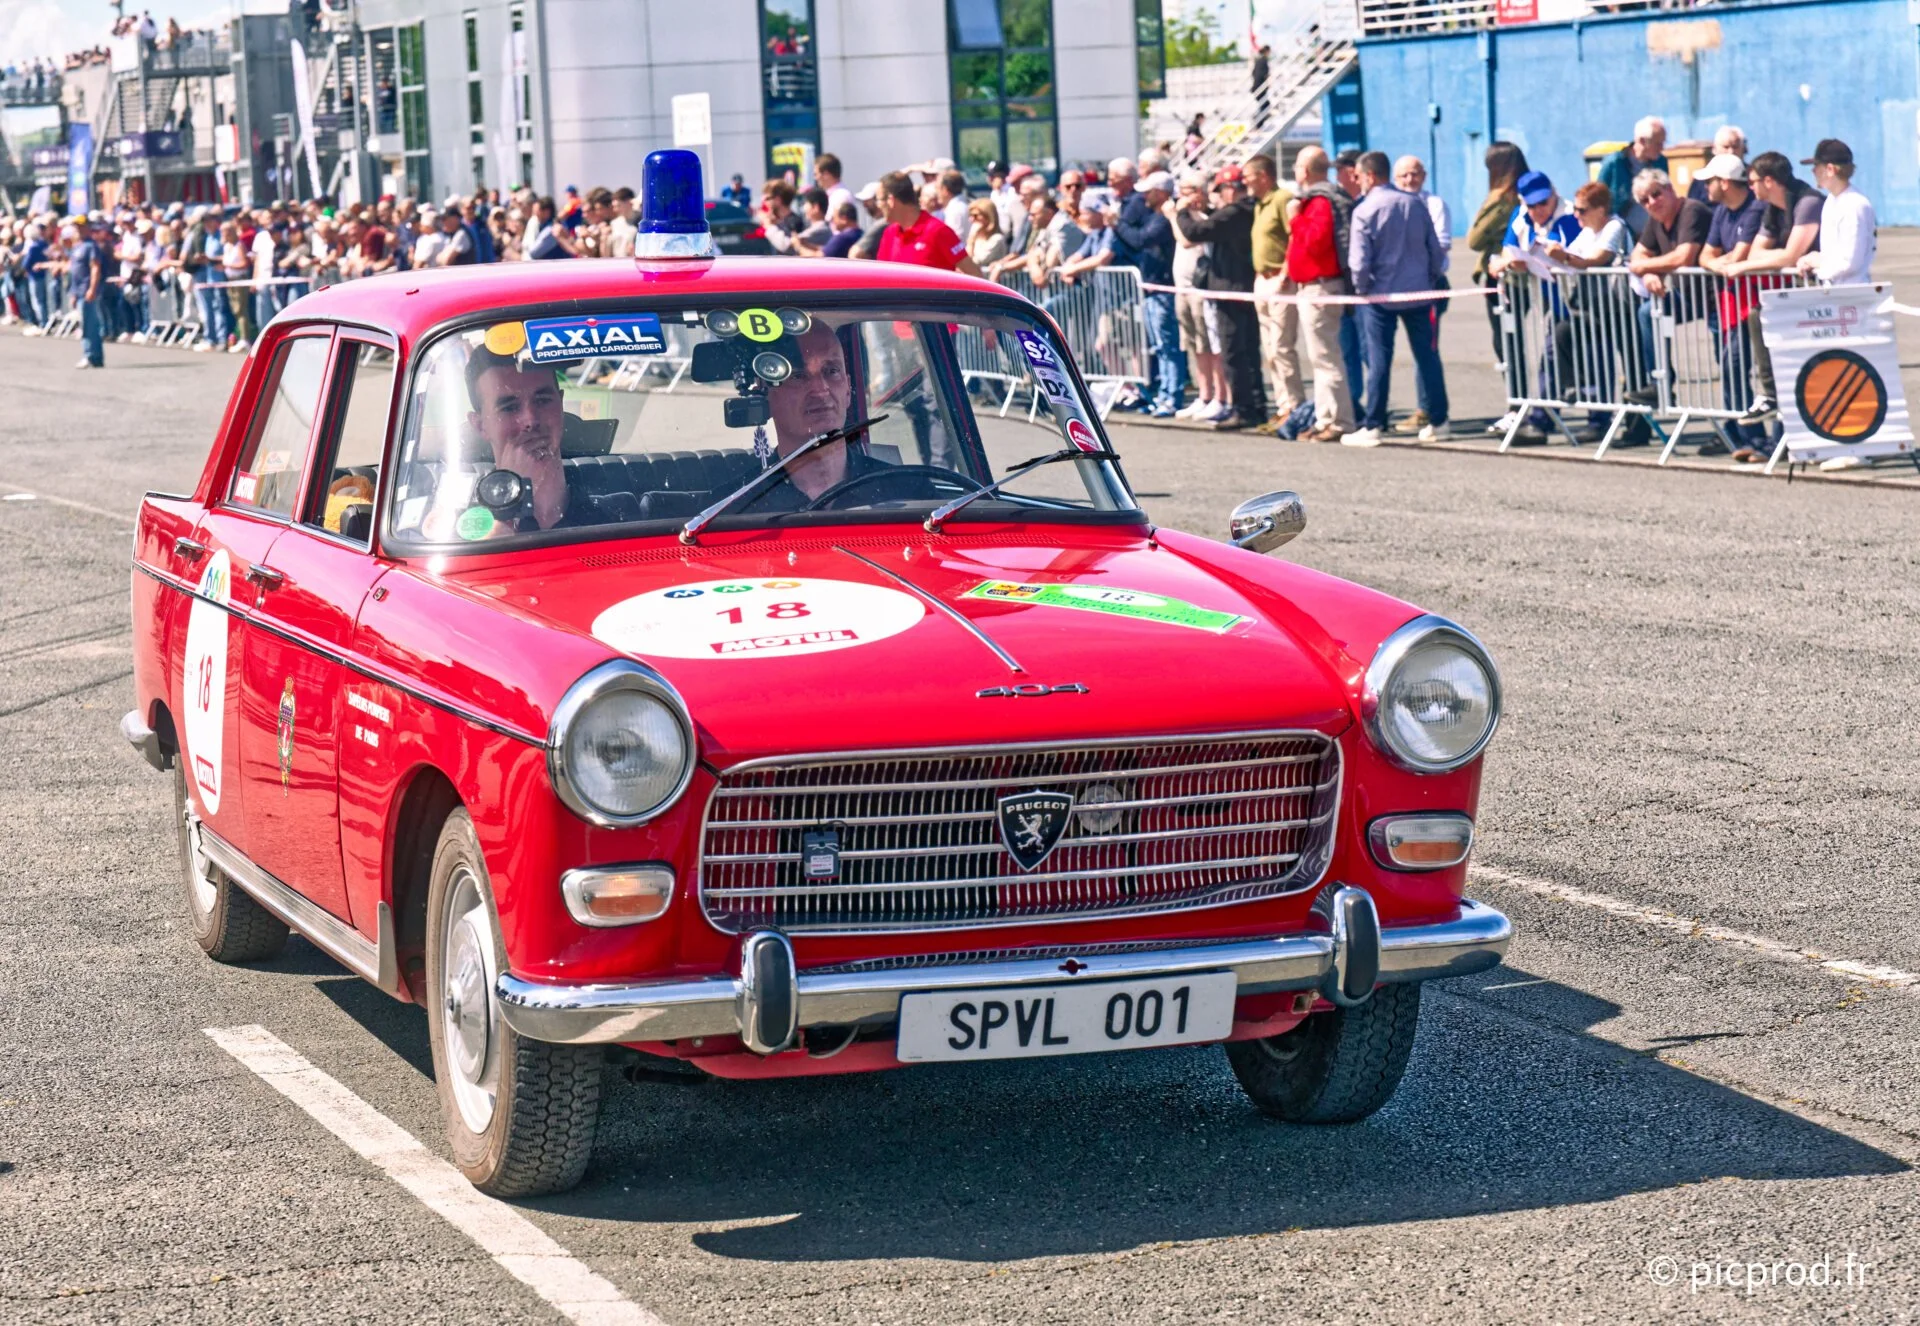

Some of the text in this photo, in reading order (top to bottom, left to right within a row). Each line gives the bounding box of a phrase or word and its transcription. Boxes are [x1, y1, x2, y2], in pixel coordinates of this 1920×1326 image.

[748, 314, 771, 336] B
[535, 325, 660, 350] AXIAL
[537, 343, 662, 359] PROFESSION CARROSSIER
[1023, 340, 1055, 361] S2
[1041, 378, 1074, 402] D2
[1099, 591, 1135, 602] 18
[716, 602, 812, 625] 18
[721, 630, 853, 653] MOTUL
[198, 653, 213, 713] 18
[976, 682, 1090, 699] 404
[1006, 801, 1068, 814] PEUGEOT
[948, 986, 1190, 1051] SPVL 001
